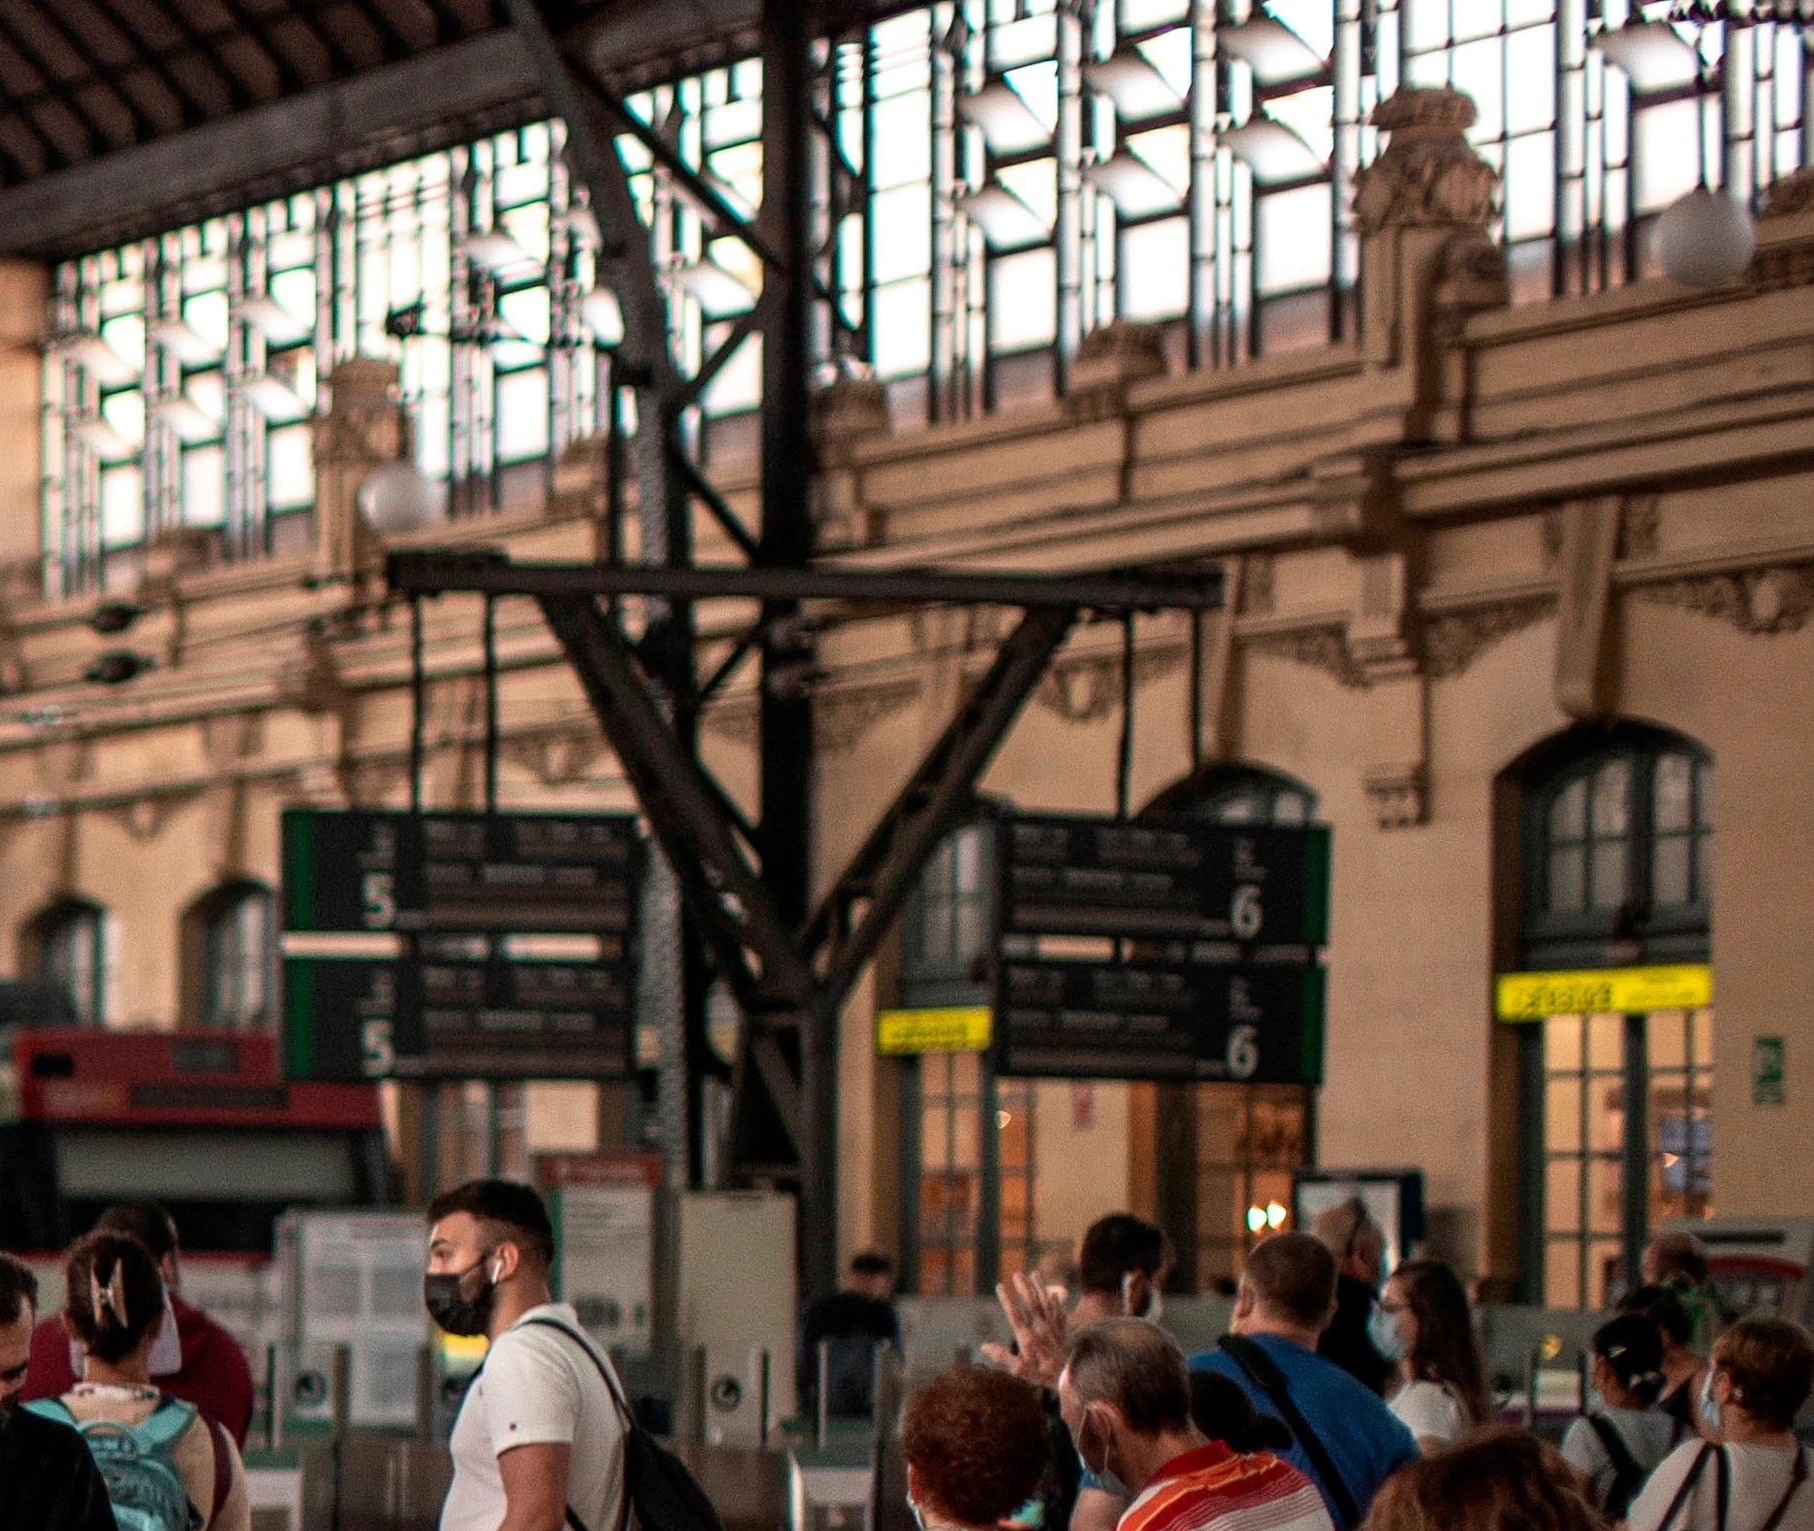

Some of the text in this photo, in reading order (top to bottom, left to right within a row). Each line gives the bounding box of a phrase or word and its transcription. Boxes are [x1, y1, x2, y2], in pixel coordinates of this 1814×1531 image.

[362, 871, 396, 930] 5
[1230, 883, 1263, 940] 6
[360, 1018, 396, 1078] 5
[1227, 1024, 1259, 1079] 6
